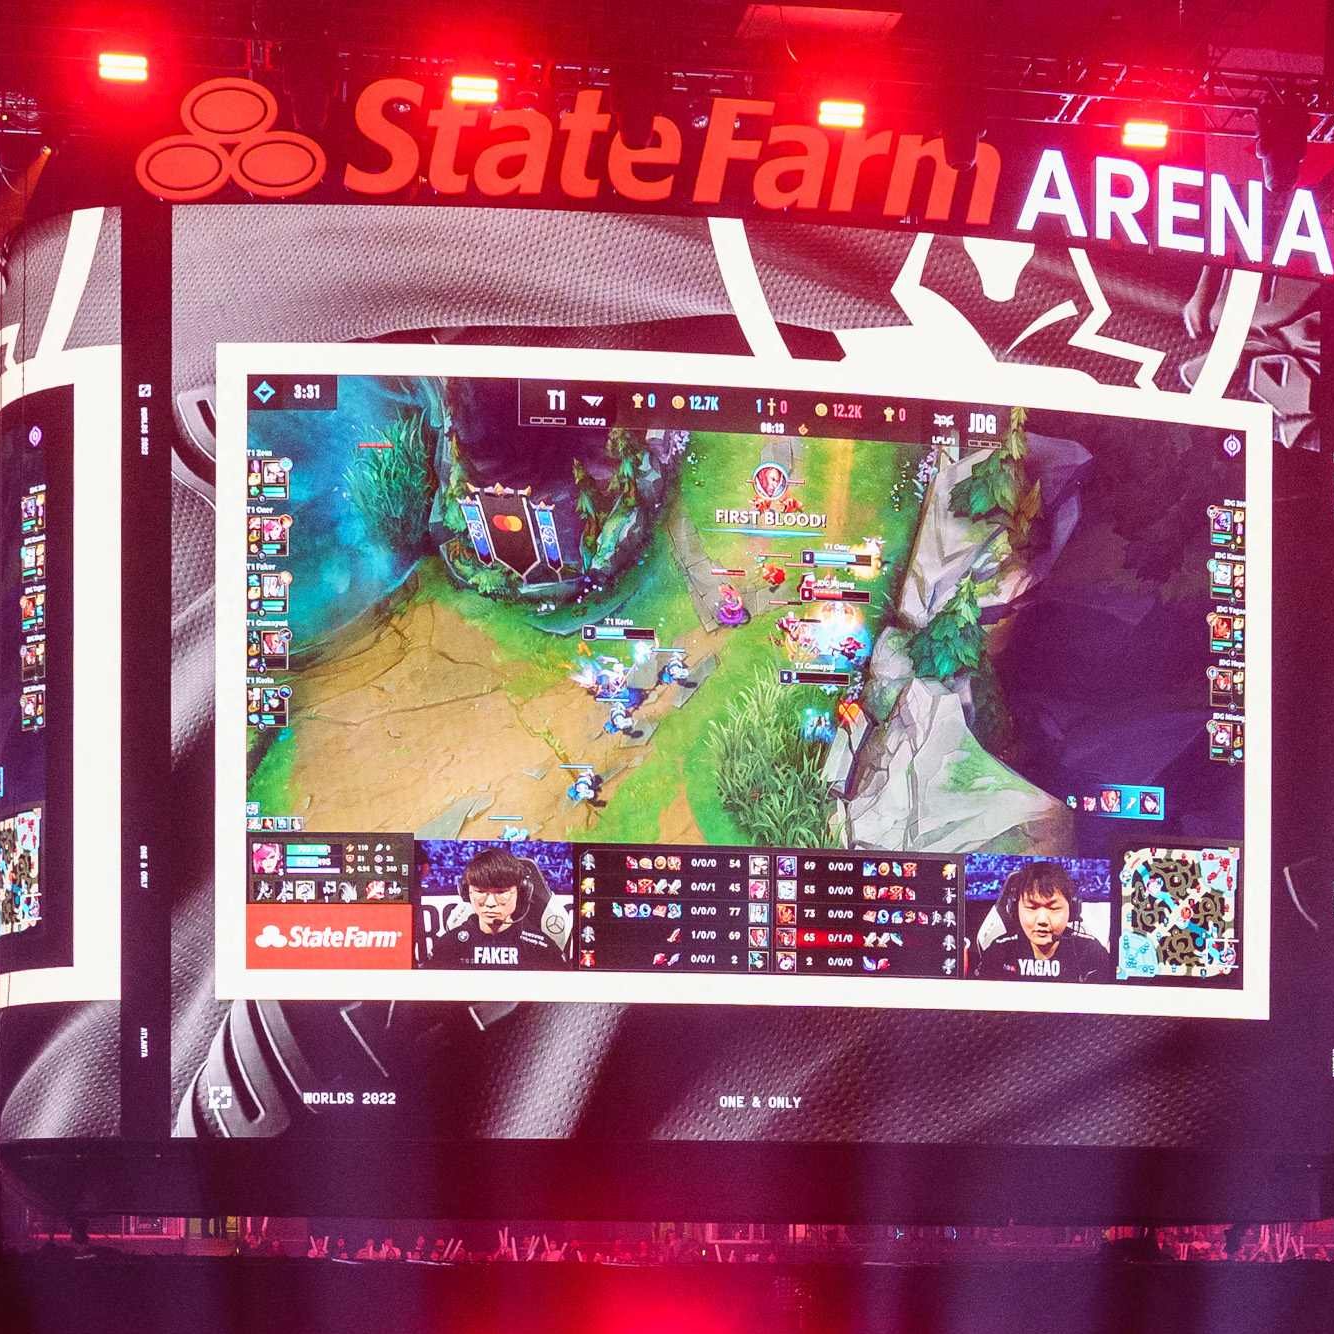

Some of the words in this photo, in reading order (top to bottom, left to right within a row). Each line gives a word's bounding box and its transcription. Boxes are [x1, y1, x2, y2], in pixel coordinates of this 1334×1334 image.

[1016, 148, 1334, 276] ARENA
[293, 384, 321, 399] 3:31
[546, 389, 566, 410] T1
[647, 392, 656, 408] 0
[688, 396, 720, 411] 12.7K
[755, 398, 762, 413] 1
[780, 400, 788, 414] 0
[832, 403, 863, 419] 12.2K
[898, 407, 907, 422] 0
[967, 412, 997, 434] JDG
[715, 508, 759, 524] FIRST
[763, 511, 827, 528] BLOOD!
[690, 858, 717, 868] 0/0/0
[828, 862, 854, 872] 0/0/0
[690, 882, 716, 892] 0/0/1
[828, 886, 854, 895] 0/0/0
[690, 906, 717, 916] 0/0/0
[827, 909, 854, 919] 0/0/0
[287, 925, 343, 948] State
[343, 926, 398, 948] Farm
[690, 930, 717, 940] 1/0/0
[827, 933, 854, 943] 0/1/0
[474, 946, 518, 965] FAKER
[690, 954, 716, 964] 0/0/1
[827, 957, 854, 967] 0/0/0
[1018, 958, 1060, 977] YAGAO
[139, 1027, 149, 1058] ATLANTA
[303, 1092, 355, 1106] WORLDS
[361, 1092, 396, 1105] 2022
[719, 1096, 744, 1109] ONE
[751, 1096, 762, 1109] &
[768, 1096, 802, 1110] ONLY
